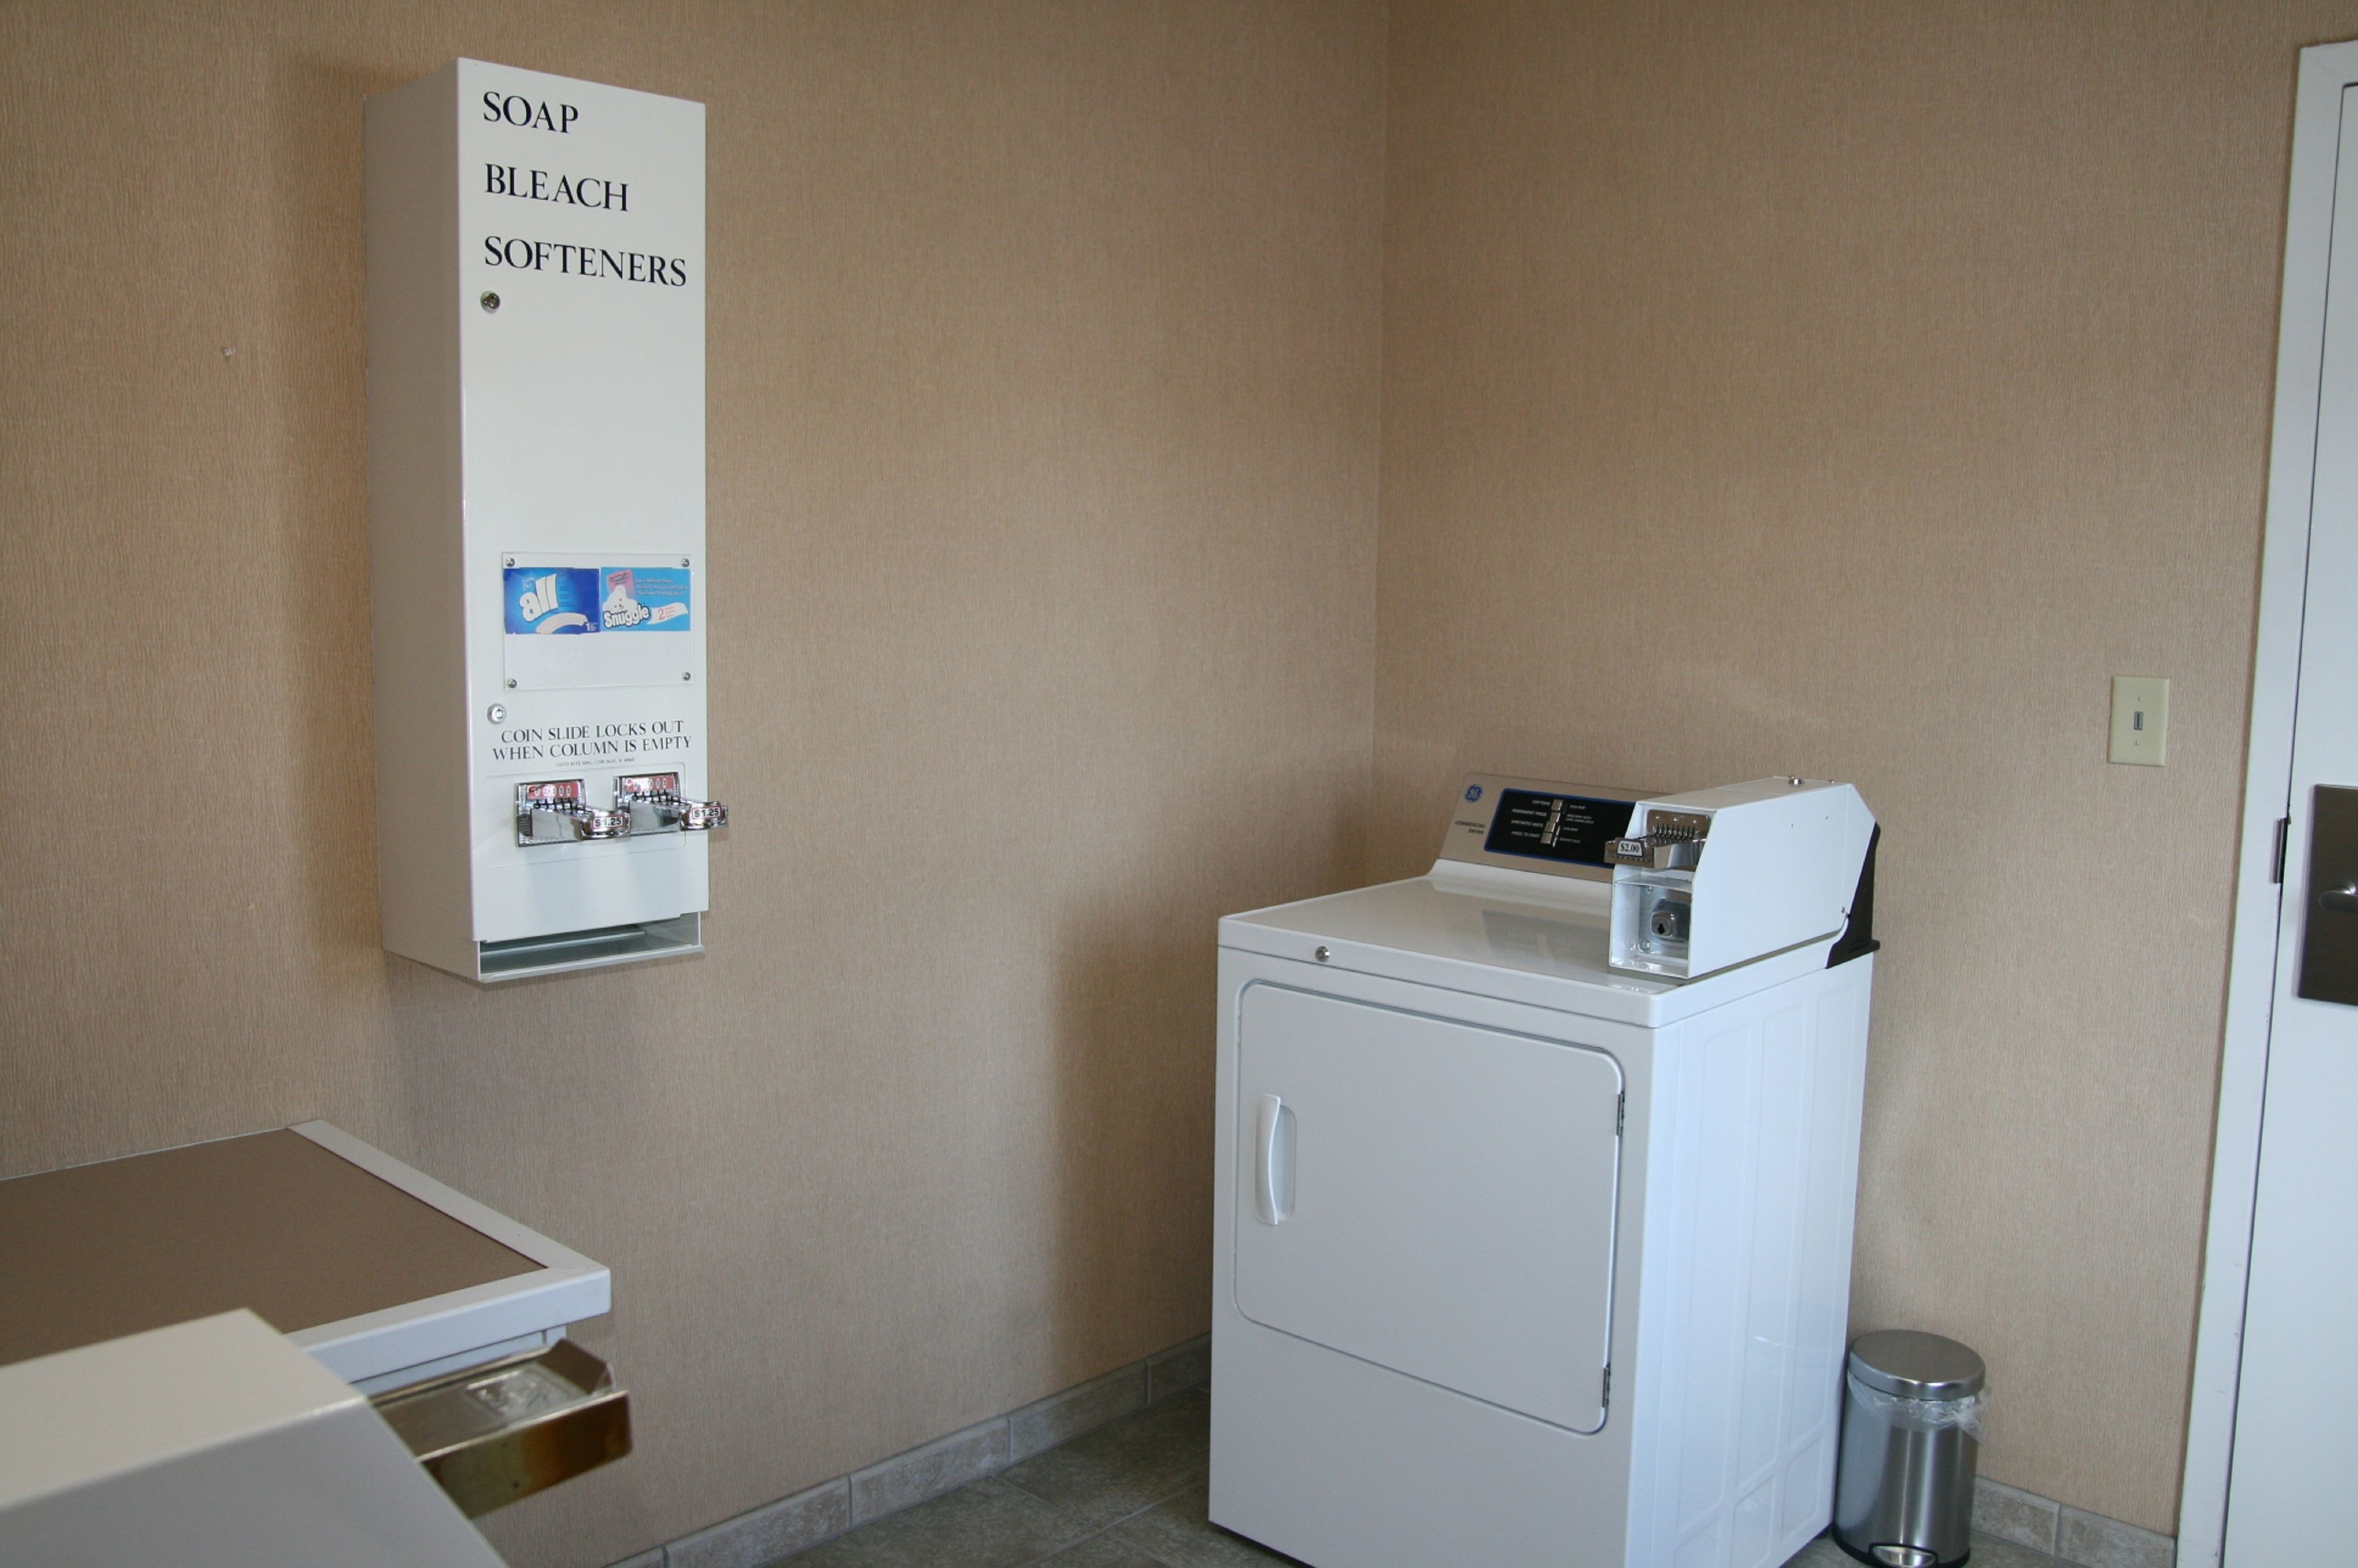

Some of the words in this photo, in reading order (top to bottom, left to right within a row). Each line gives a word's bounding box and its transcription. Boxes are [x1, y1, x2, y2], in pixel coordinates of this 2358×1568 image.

[483, 91, 579, 133] SOAP
[484, 163, 629, 212] BLEACH
[484, 235, 687, 287] SOFTENERS
[519, 573, 559, 622] all
[604, 602, 650, 629] Snuggle
[657, 608, 666, 621] 2
[501, 729, 543, 743] COIN
[548, 725, 590, 740] SLIDE
[596, 722, 647, 737] LOCKS
[652, 720, 684, 734] OUT
[493, 745, 543, 761] WHEN
[550, 740, 618, 758] COLUMN
[625, 739, 637, 753] IS
[643, 735, 692, 751] EMPTY
[1620, 842, 1640, 853] $2.00
